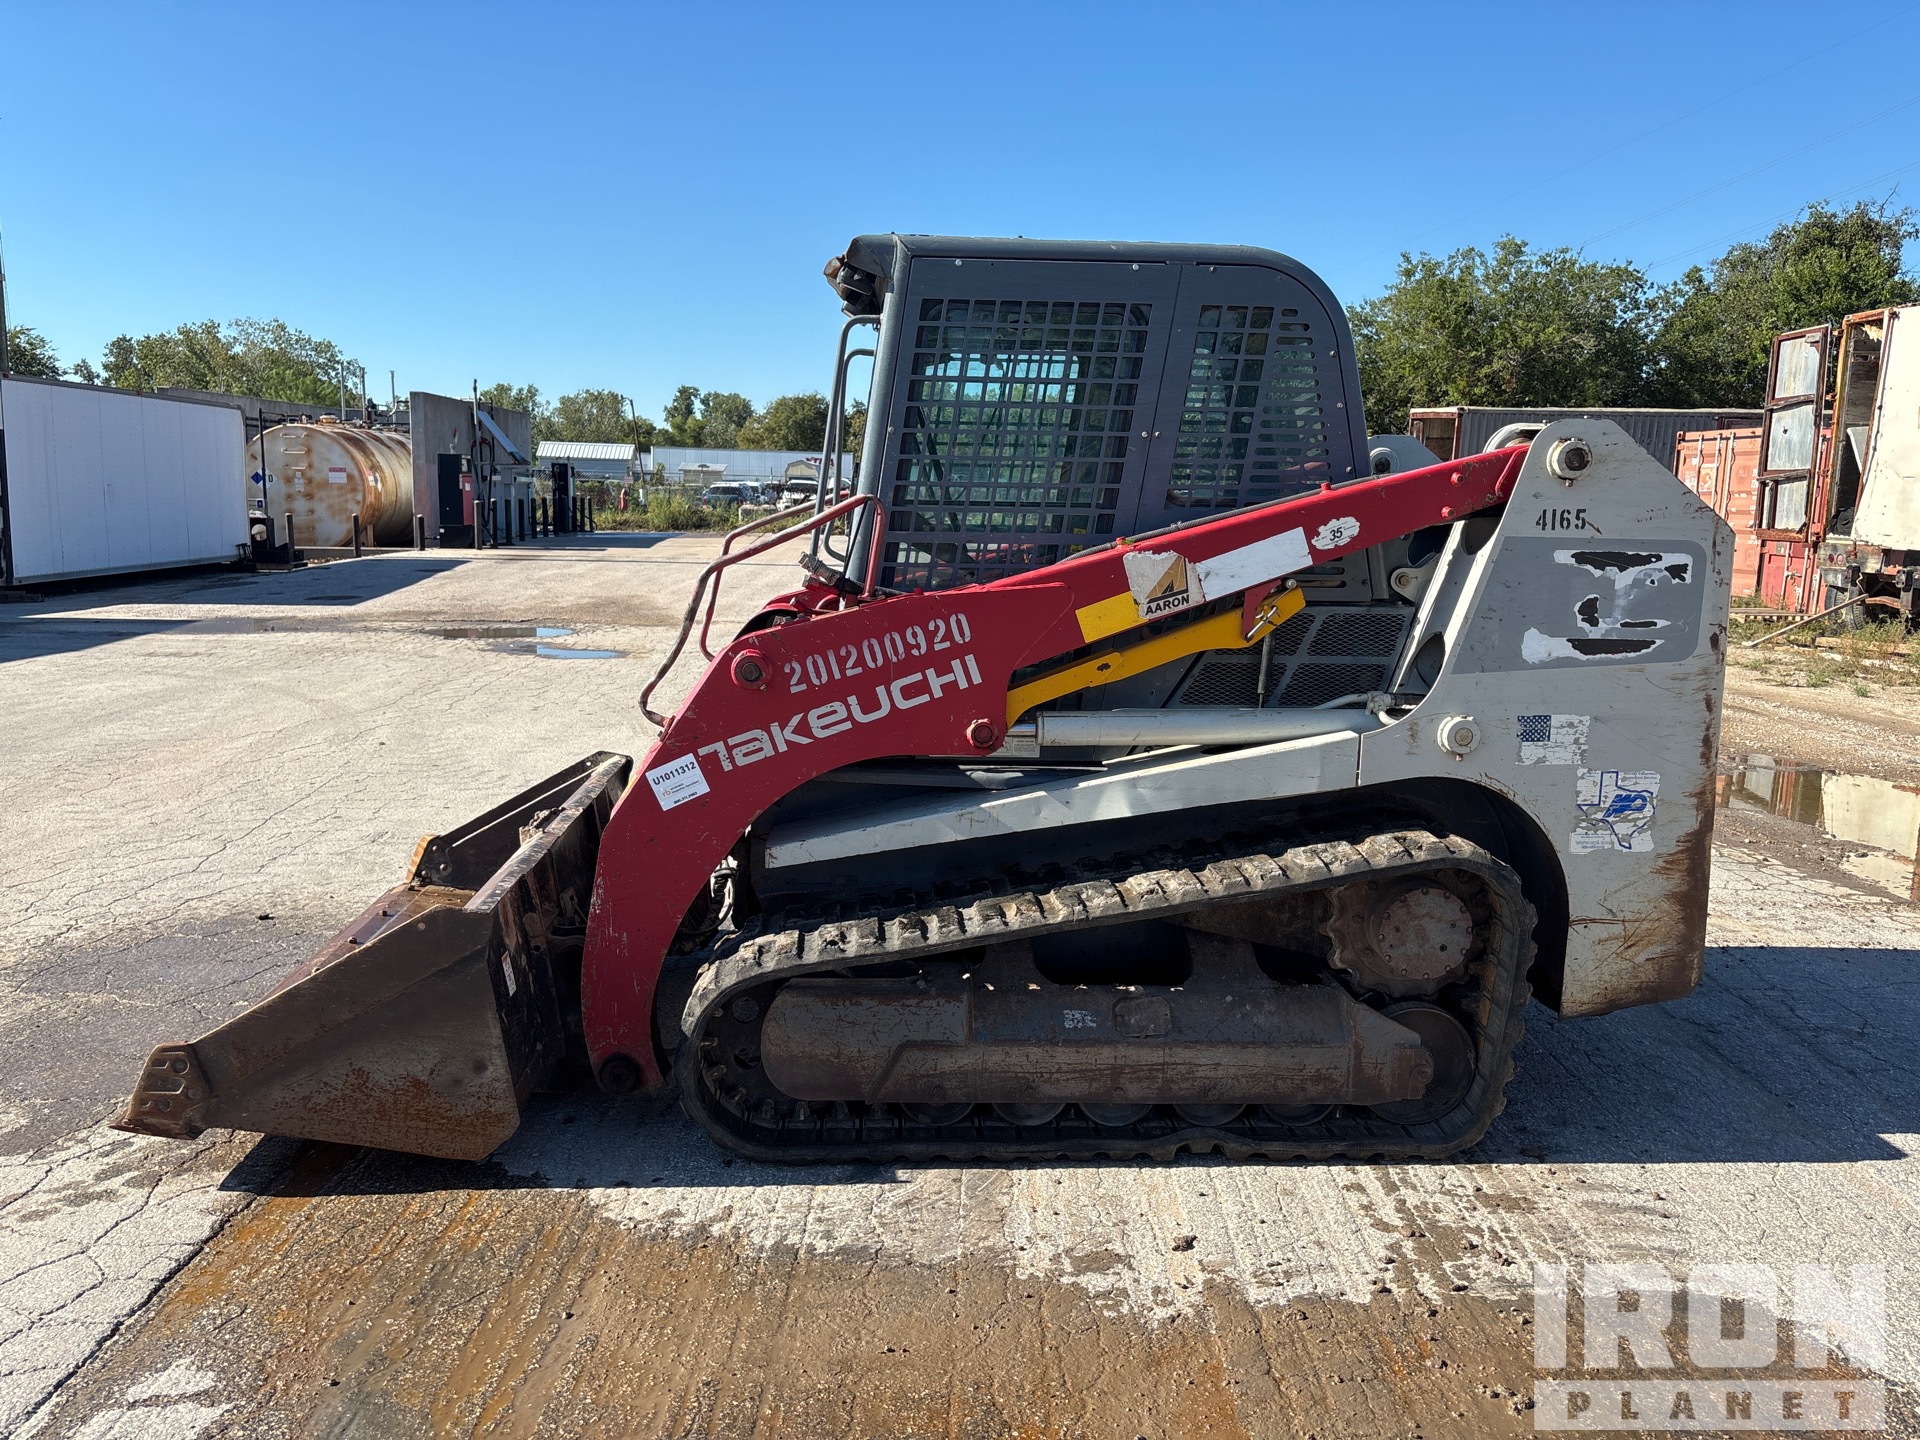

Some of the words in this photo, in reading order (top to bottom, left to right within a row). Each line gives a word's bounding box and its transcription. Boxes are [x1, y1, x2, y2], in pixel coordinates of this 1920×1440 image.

[1535, 508, 1587, 531] 4165
[1330, 526, 1343, 541] 35
[1145, 594, 1190, 616] AARON
[784, 612, 972, 694] 201200920
[652, 761, 697, 786] U1011312
